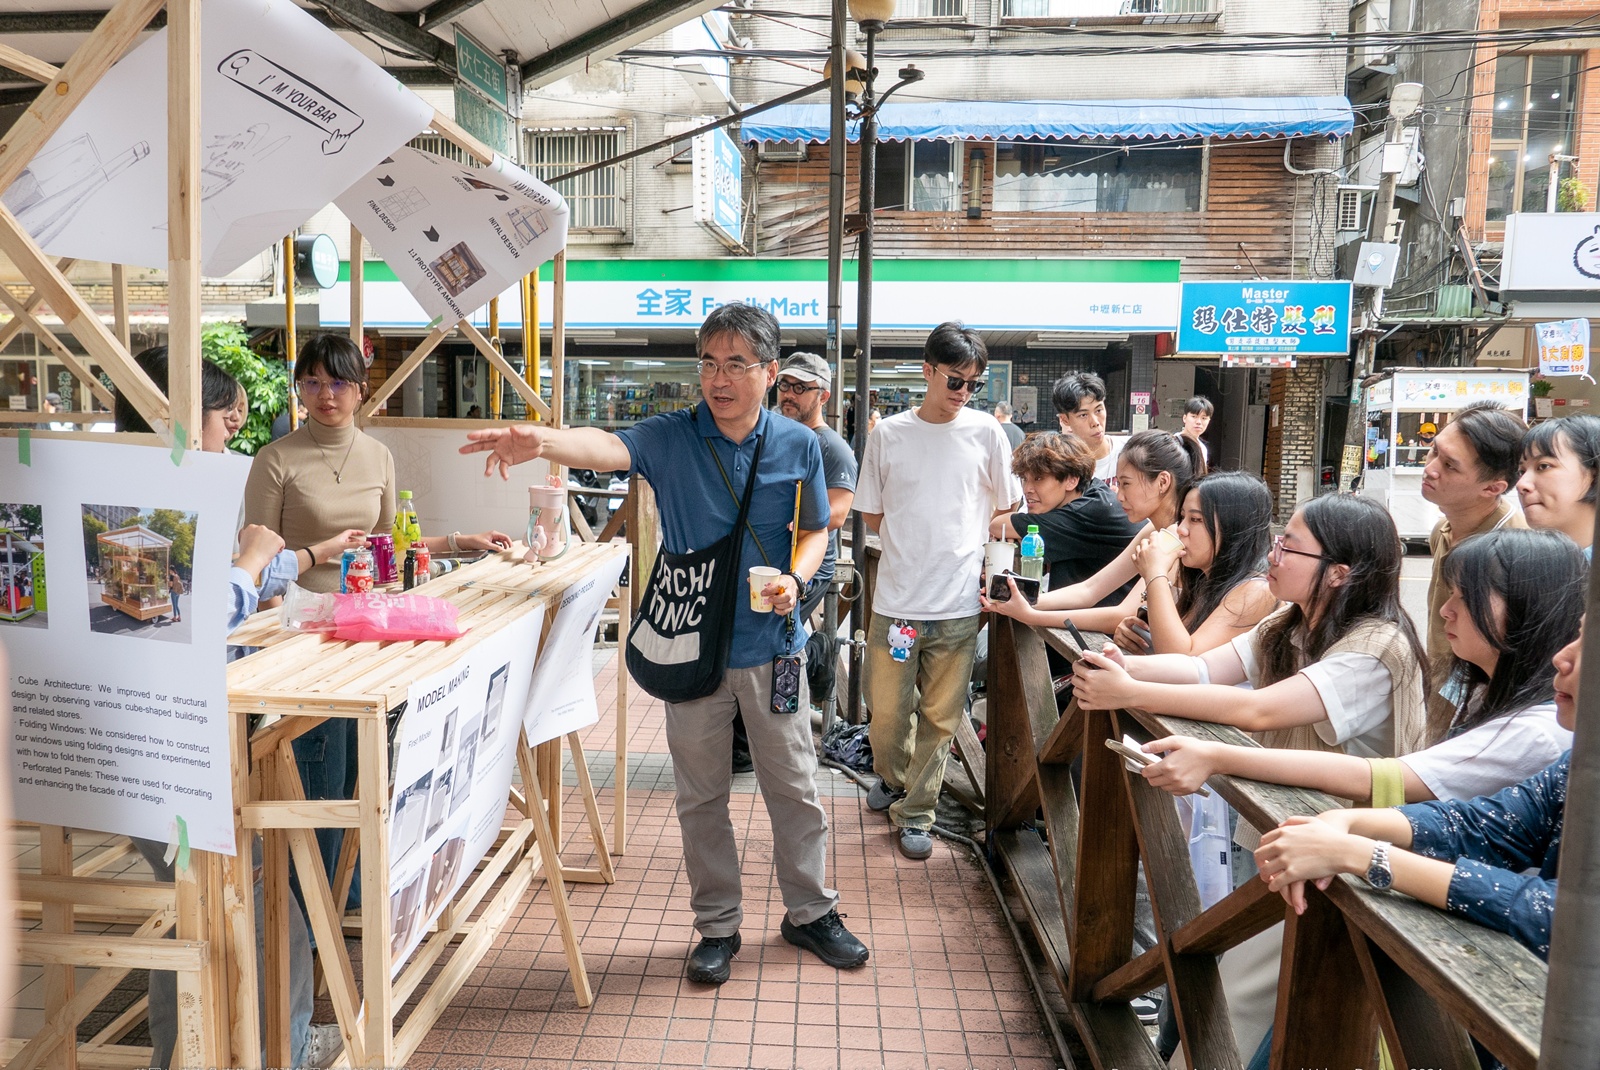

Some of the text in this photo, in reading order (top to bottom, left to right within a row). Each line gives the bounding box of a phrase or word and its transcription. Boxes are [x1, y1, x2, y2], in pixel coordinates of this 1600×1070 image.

[461, 46, 501, 94] 大仁五街
[285, 88, 319, 112] YOUR
[311, 105, 338, 124] BAR
[367, 200, 397, 233] FINAL DESIGN
[488, 216, 502, 236] INITAL
[500, 233, 520, 259] DESIGN
[407, 248, 465, 319] 1:1 PROTOTYPE AMSKING
[1241, 287, 1290, 299] Master
[636, 288, 692, 316] 全家
[1193, 304, 1336, 335] 瑪仕特髮型
[1570, 365, 1584, 373] $99
[18, 676, 207, 708] Cube Architecture: We improved our structural
[416, 665, 470, 714] MODEL MAKING
[11, 690, 208, 725] design by observing various cube-shaped buildings
[13, 705, 83, 720] and related stores.
[15, 734, 211, 769] our windows using folding designs and experimented
[19, 719, 210, 754] Folding Windows: We considered how to construct
[16, 748, 119, 768] with how to fold them open.
[19, 776, 167, 805] and enhancing the facade of our design.
[22, 762, 213, 801] Perforated Panels: These were used for decorating
